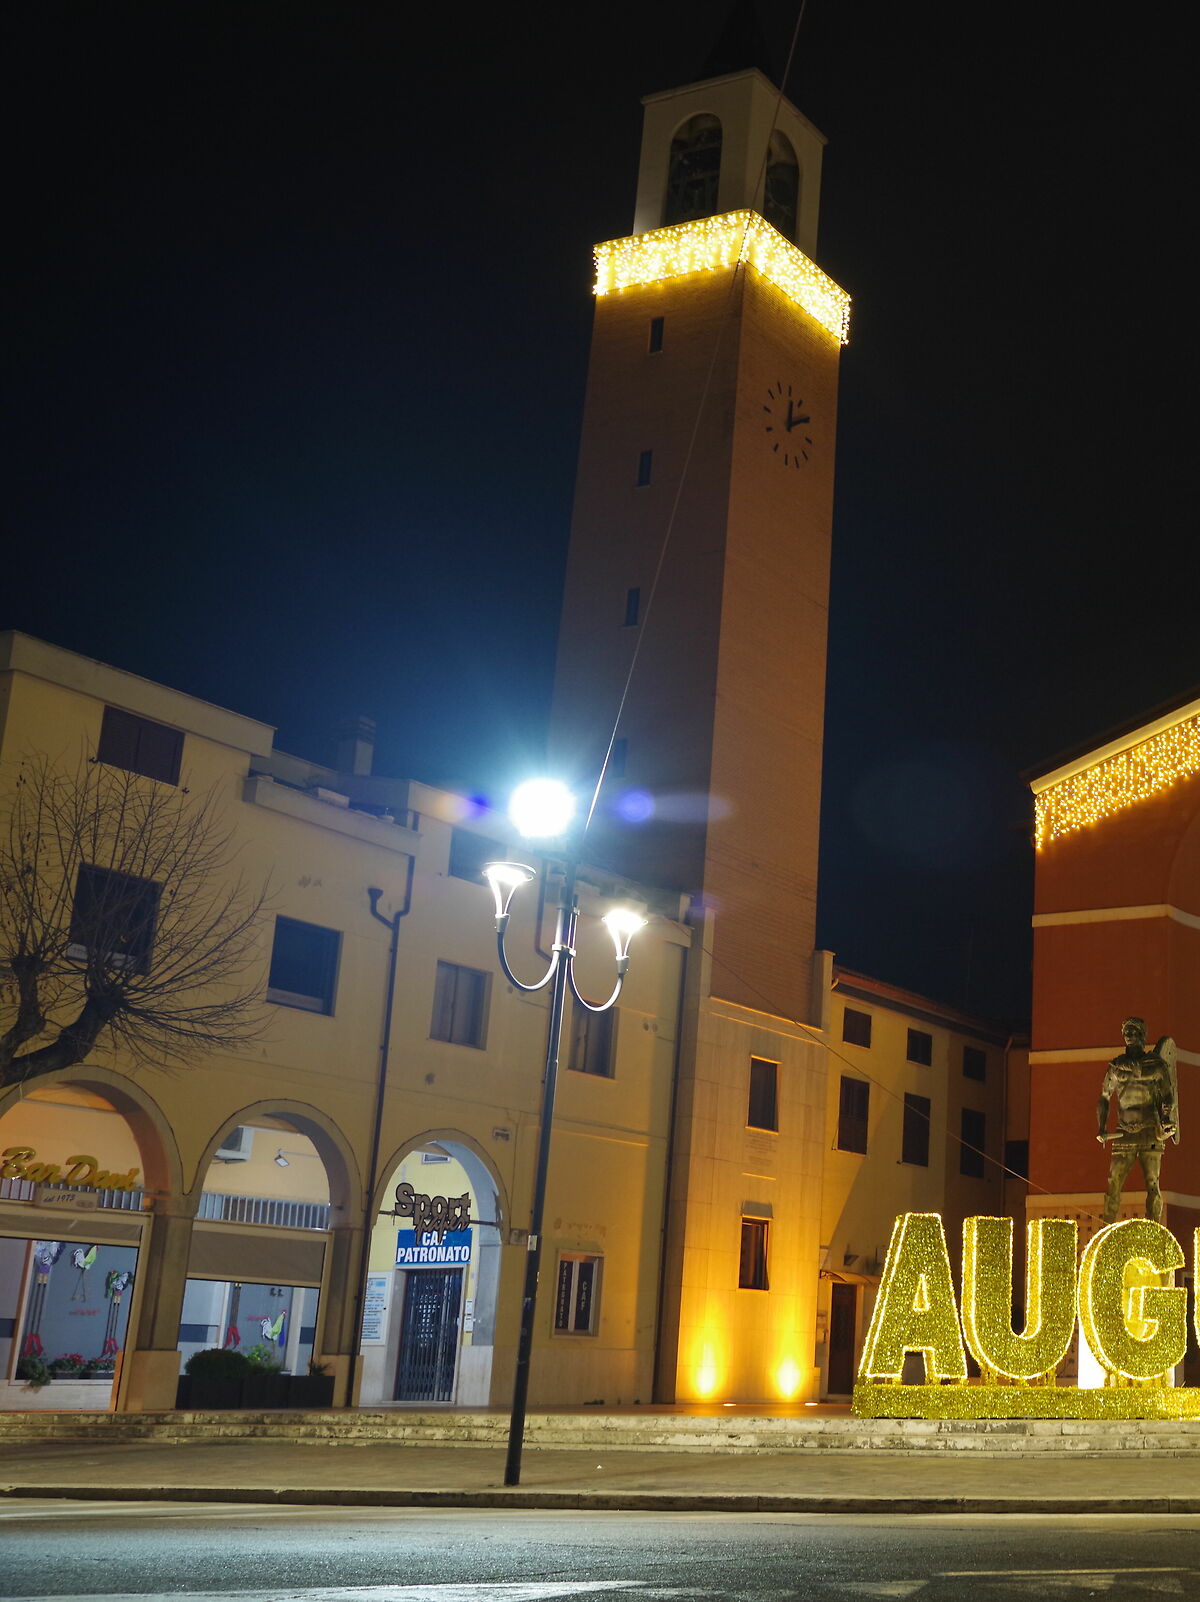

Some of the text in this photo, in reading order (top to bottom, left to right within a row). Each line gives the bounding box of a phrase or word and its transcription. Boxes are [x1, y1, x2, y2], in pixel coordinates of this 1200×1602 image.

[0, 1146, 63, 1184] Bar
[395, 1182, 471, 1226] Sport
[396, 1245, 470, 1263] PATRONATO
[580, 1280, 588, 1311] CAF
